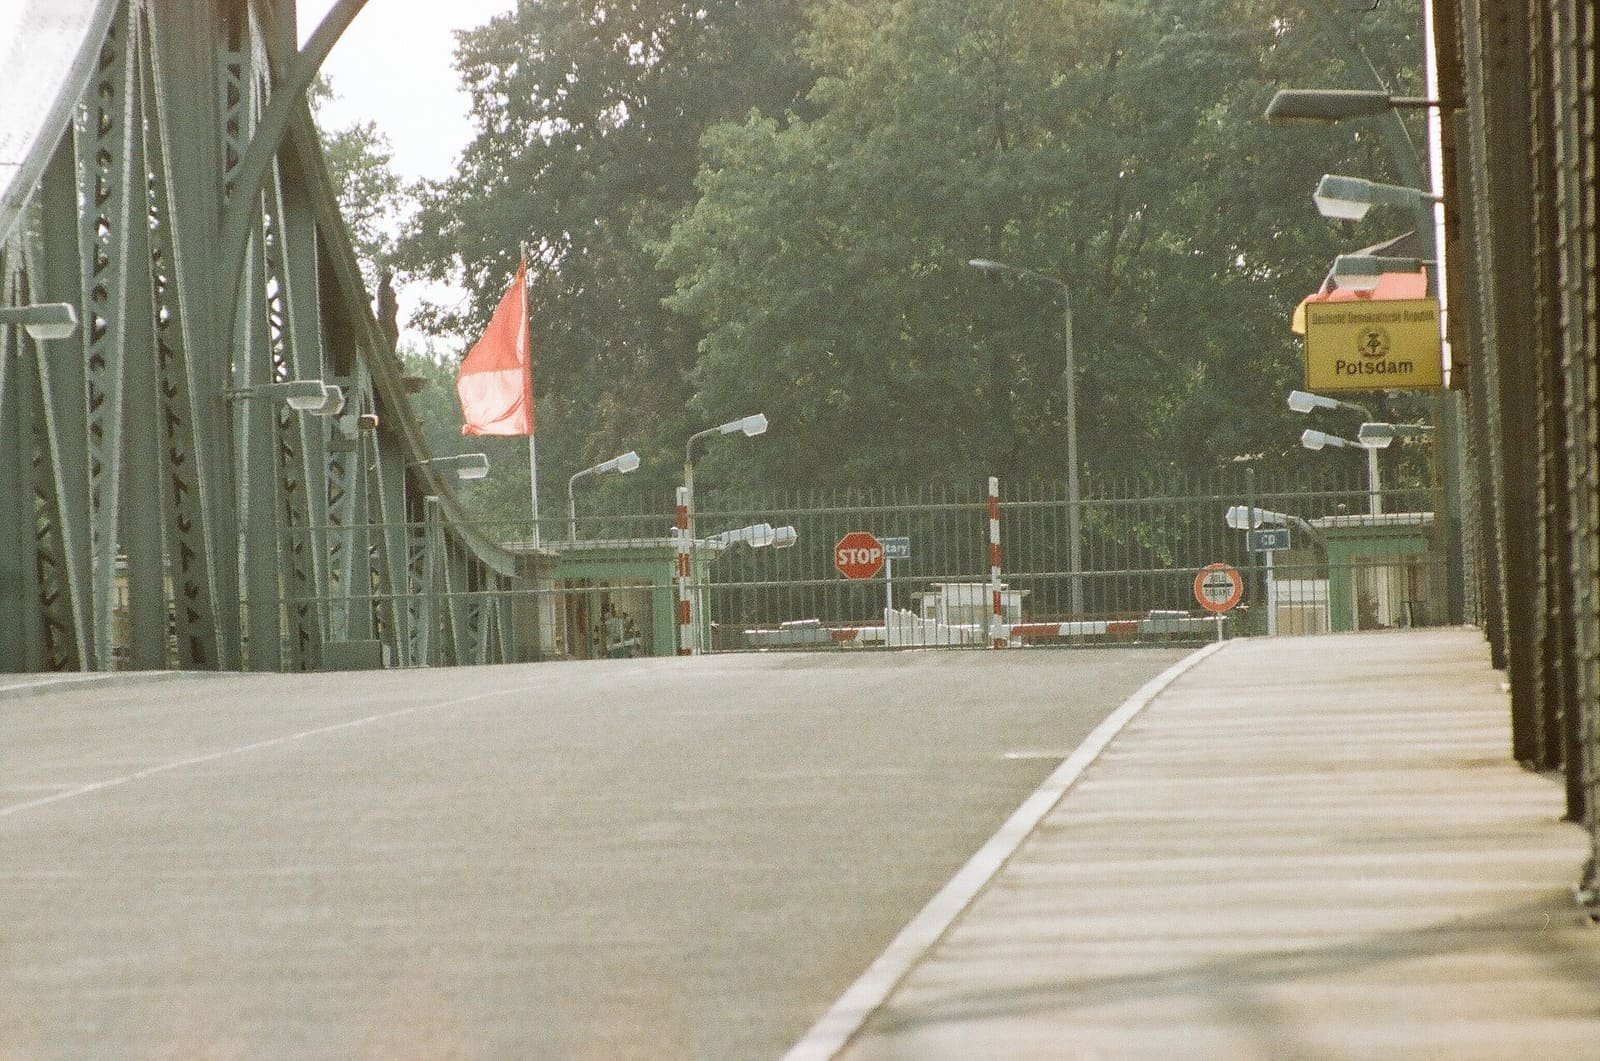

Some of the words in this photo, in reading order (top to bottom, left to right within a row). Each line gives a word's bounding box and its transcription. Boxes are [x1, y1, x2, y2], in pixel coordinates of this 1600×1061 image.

[1336, 360, 1414, 375] Potsdam
[1262, 534, 1275, 545] CD
[885, 544, 907, 555] tary
[839, 548, 881, 565] STOP
